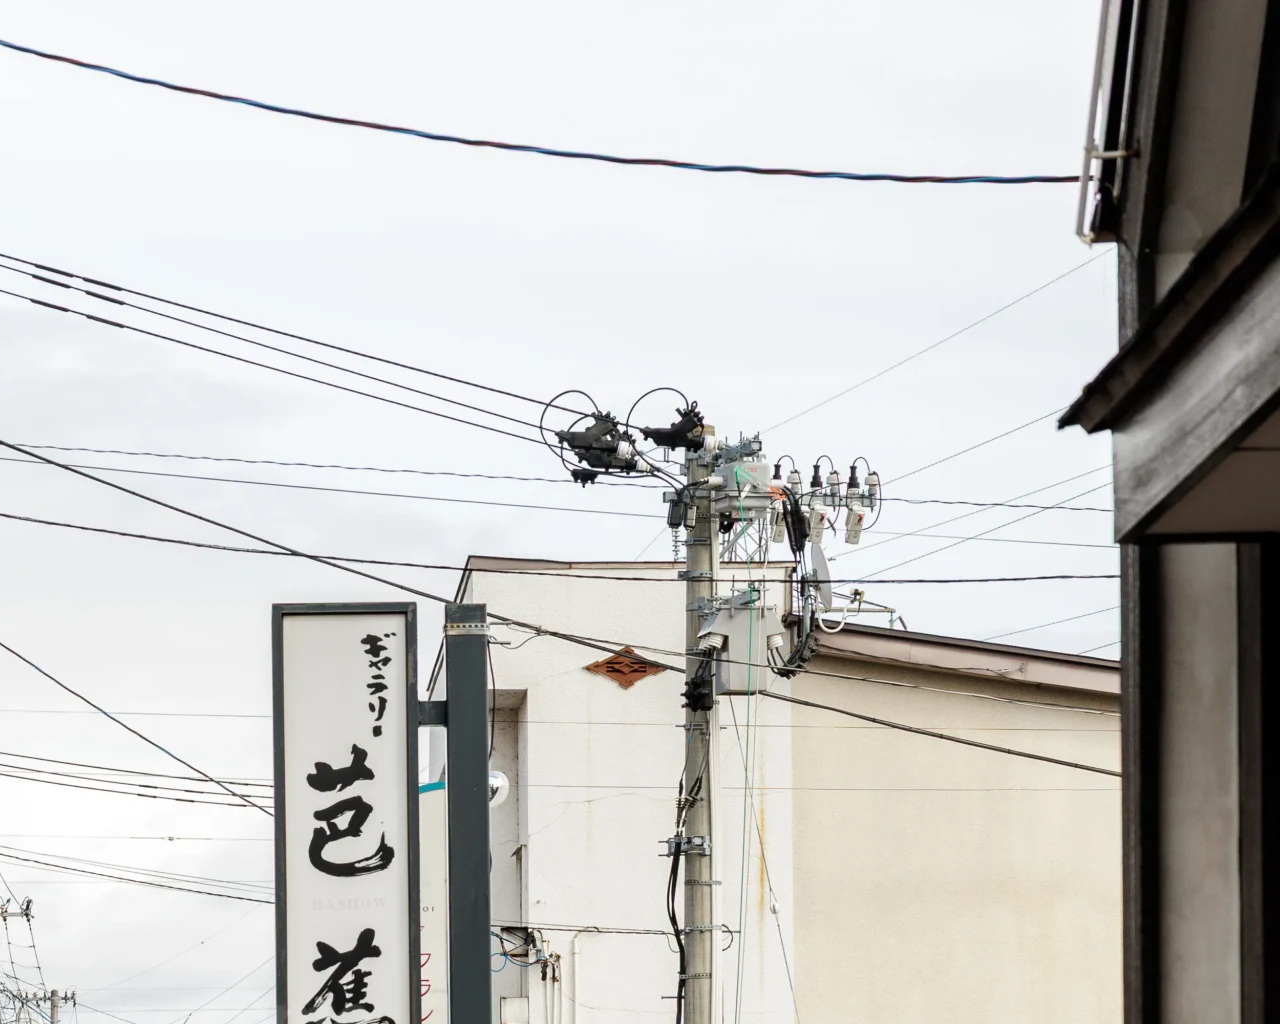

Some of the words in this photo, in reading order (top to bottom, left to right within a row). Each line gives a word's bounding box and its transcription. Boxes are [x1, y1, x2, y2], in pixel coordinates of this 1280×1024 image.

[360, 632, 397, 737] ギャラリー
[312, 897, 388, 911] BASHOW
